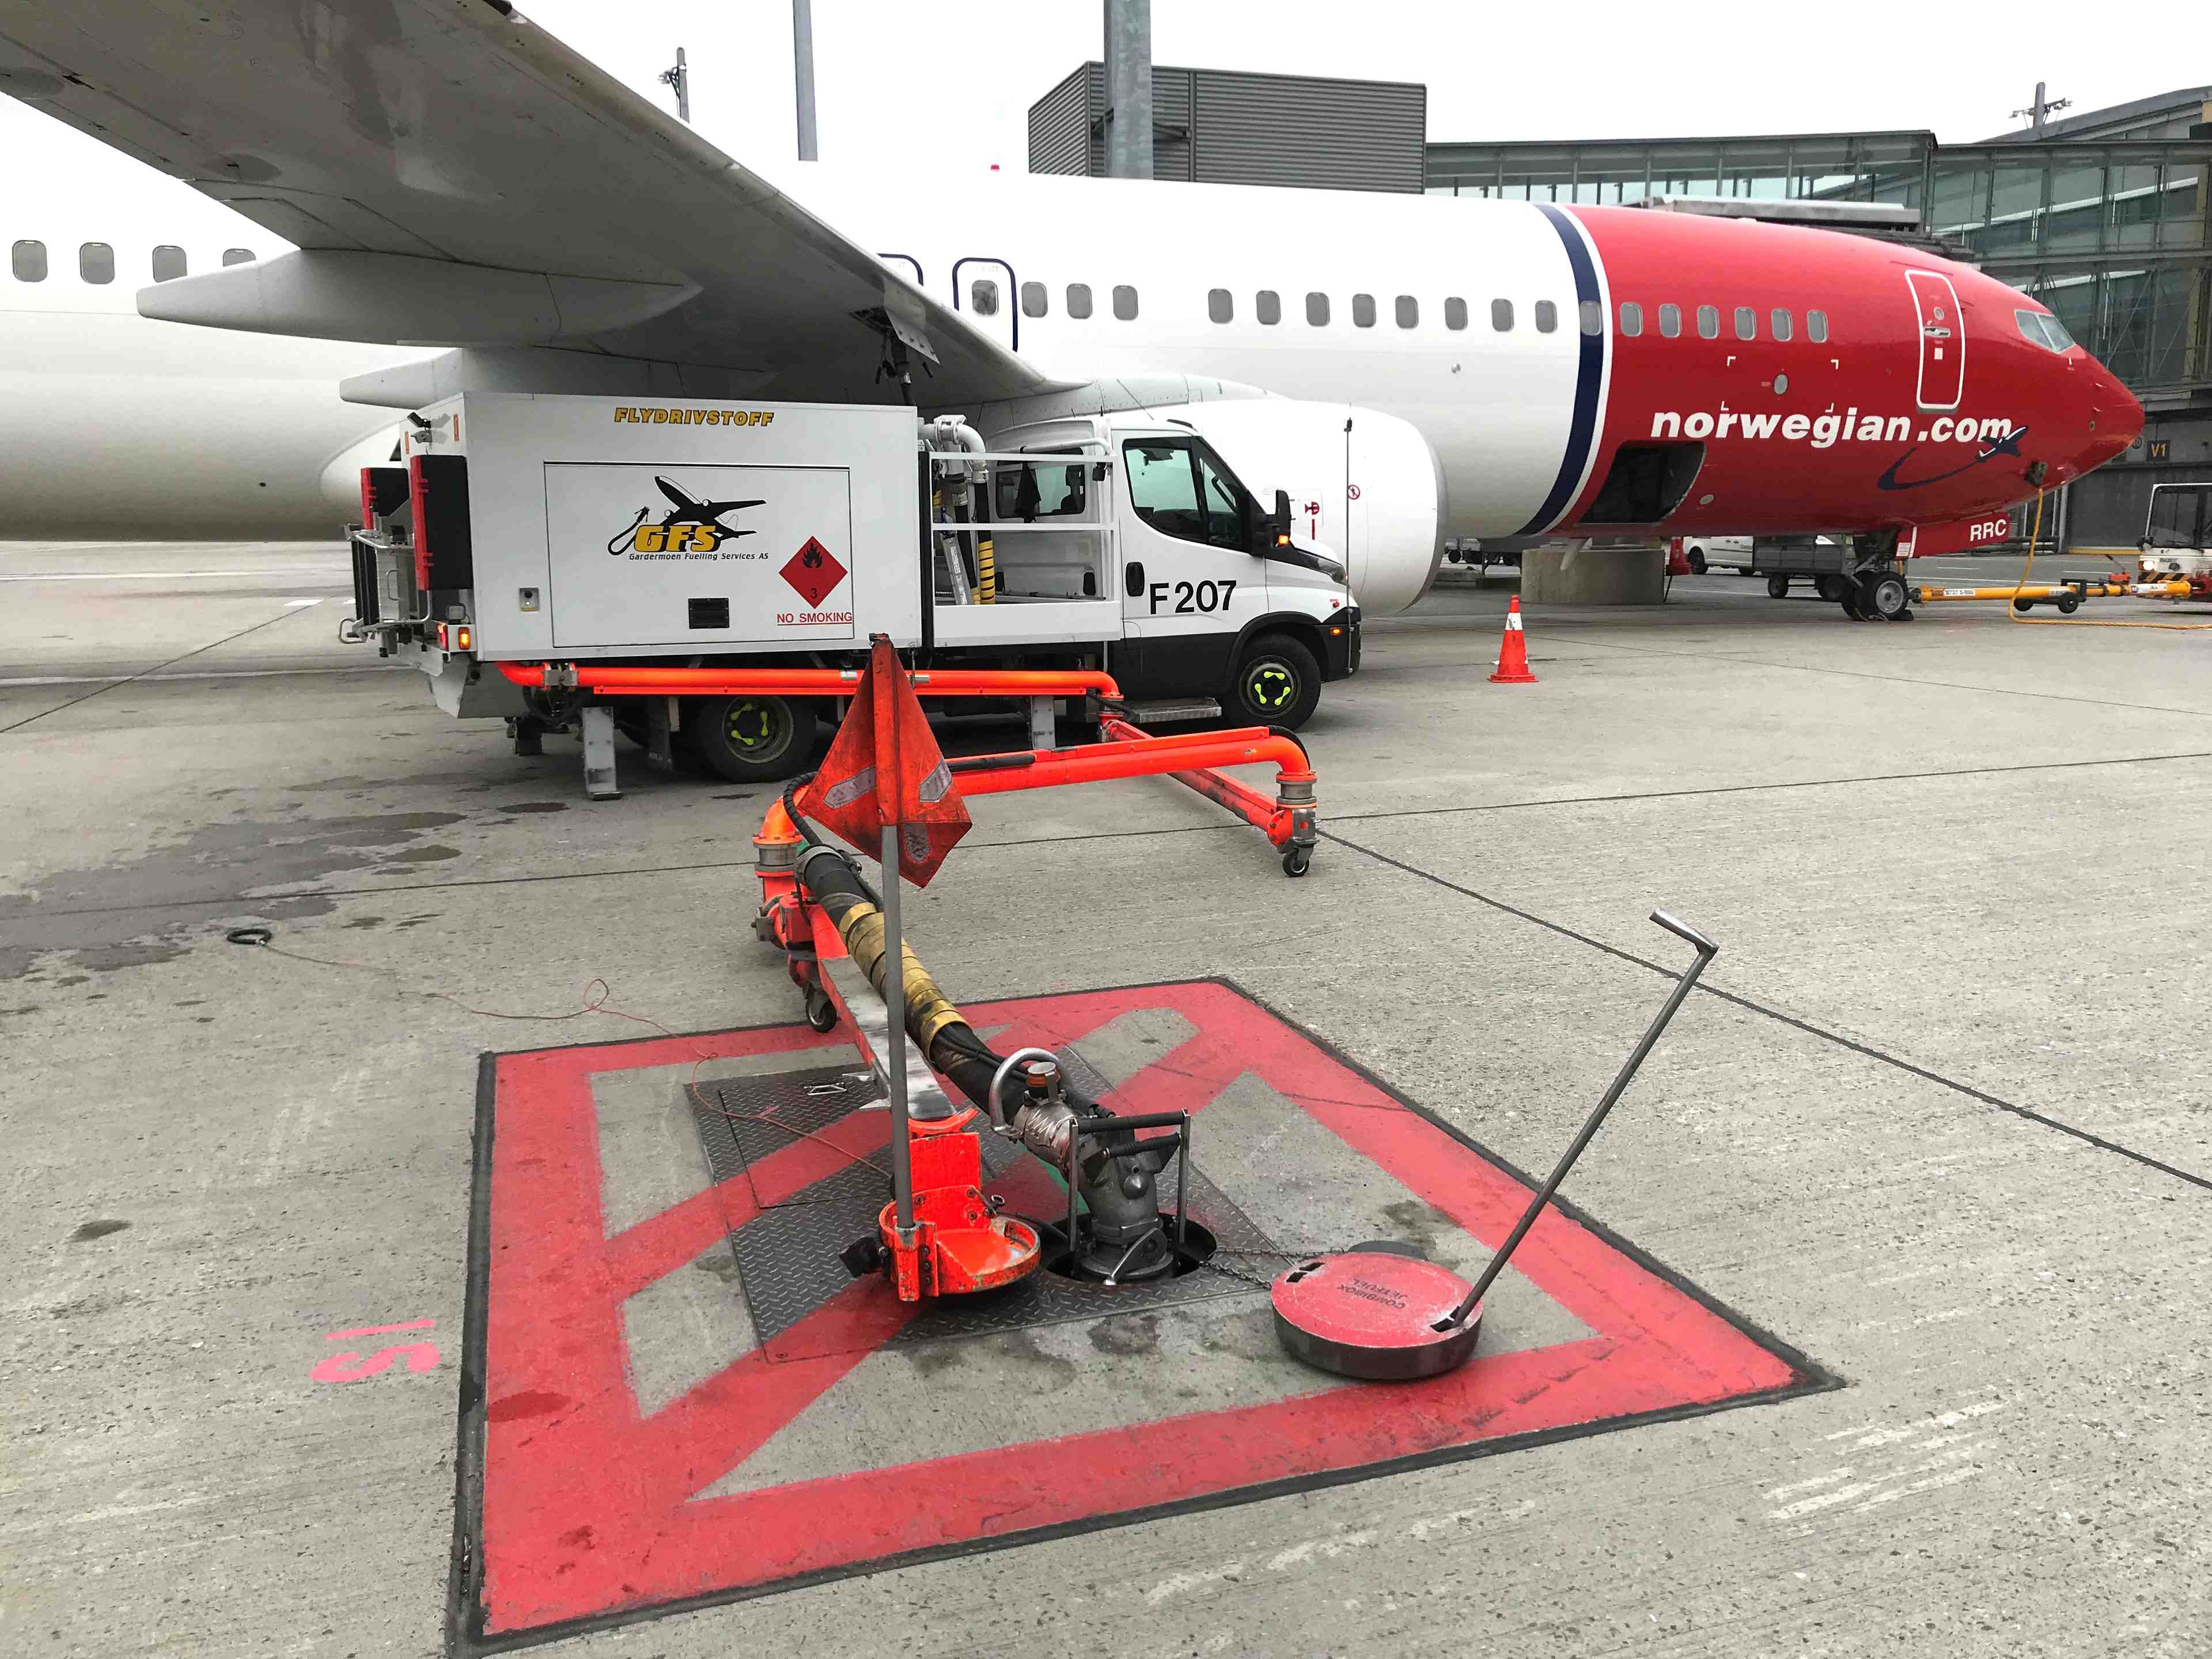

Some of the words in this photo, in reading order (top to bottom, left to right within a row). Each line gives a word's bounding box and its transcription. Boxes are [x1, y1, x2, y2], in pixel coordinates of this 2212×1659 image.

[614, 407, 775, 426] FLYDRIVSTOFF
[2151, 443, 2166, 457] V1
[1970, 519, 2007, 541] RRC
[634, 525, 721, 552] GFS
[684, 553, 718, 561] Fuelling
[810, 588, 818, 599] 3
[777, 613, 794, 623] NO
[799, 612, 853, 623] SMOKING
